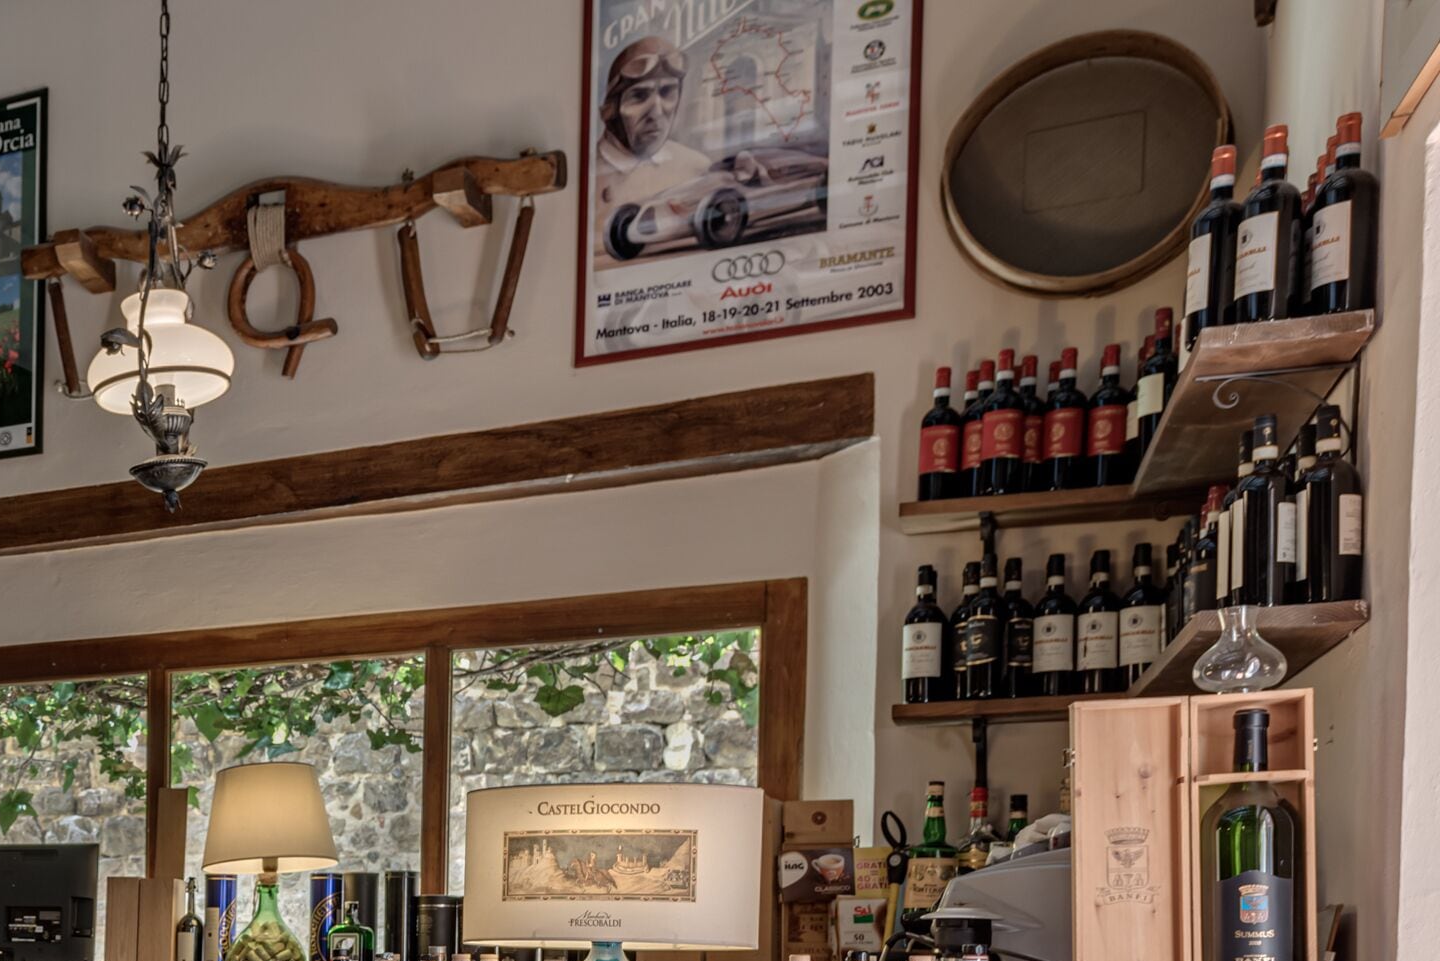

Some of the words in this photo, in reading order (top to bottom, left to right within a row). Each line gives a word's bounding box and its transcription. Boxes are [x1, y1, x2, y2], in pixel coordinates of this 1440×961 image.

[818, 246, 896, 268] BRAMANTE
[647, 279, 693, 293] POPOLARE
[626, 291, 669, 303] MANTOVA
[595, 323, 651, 341] Mantova
[661, 313, 698, 331] Italia,
[786, 290, 854, 312] Settembre
[857, 281, 894, 300] 2003
[1109, 894, 1148, 903] BANFI
[1234, 929, 1276, 940] SUMMUS
